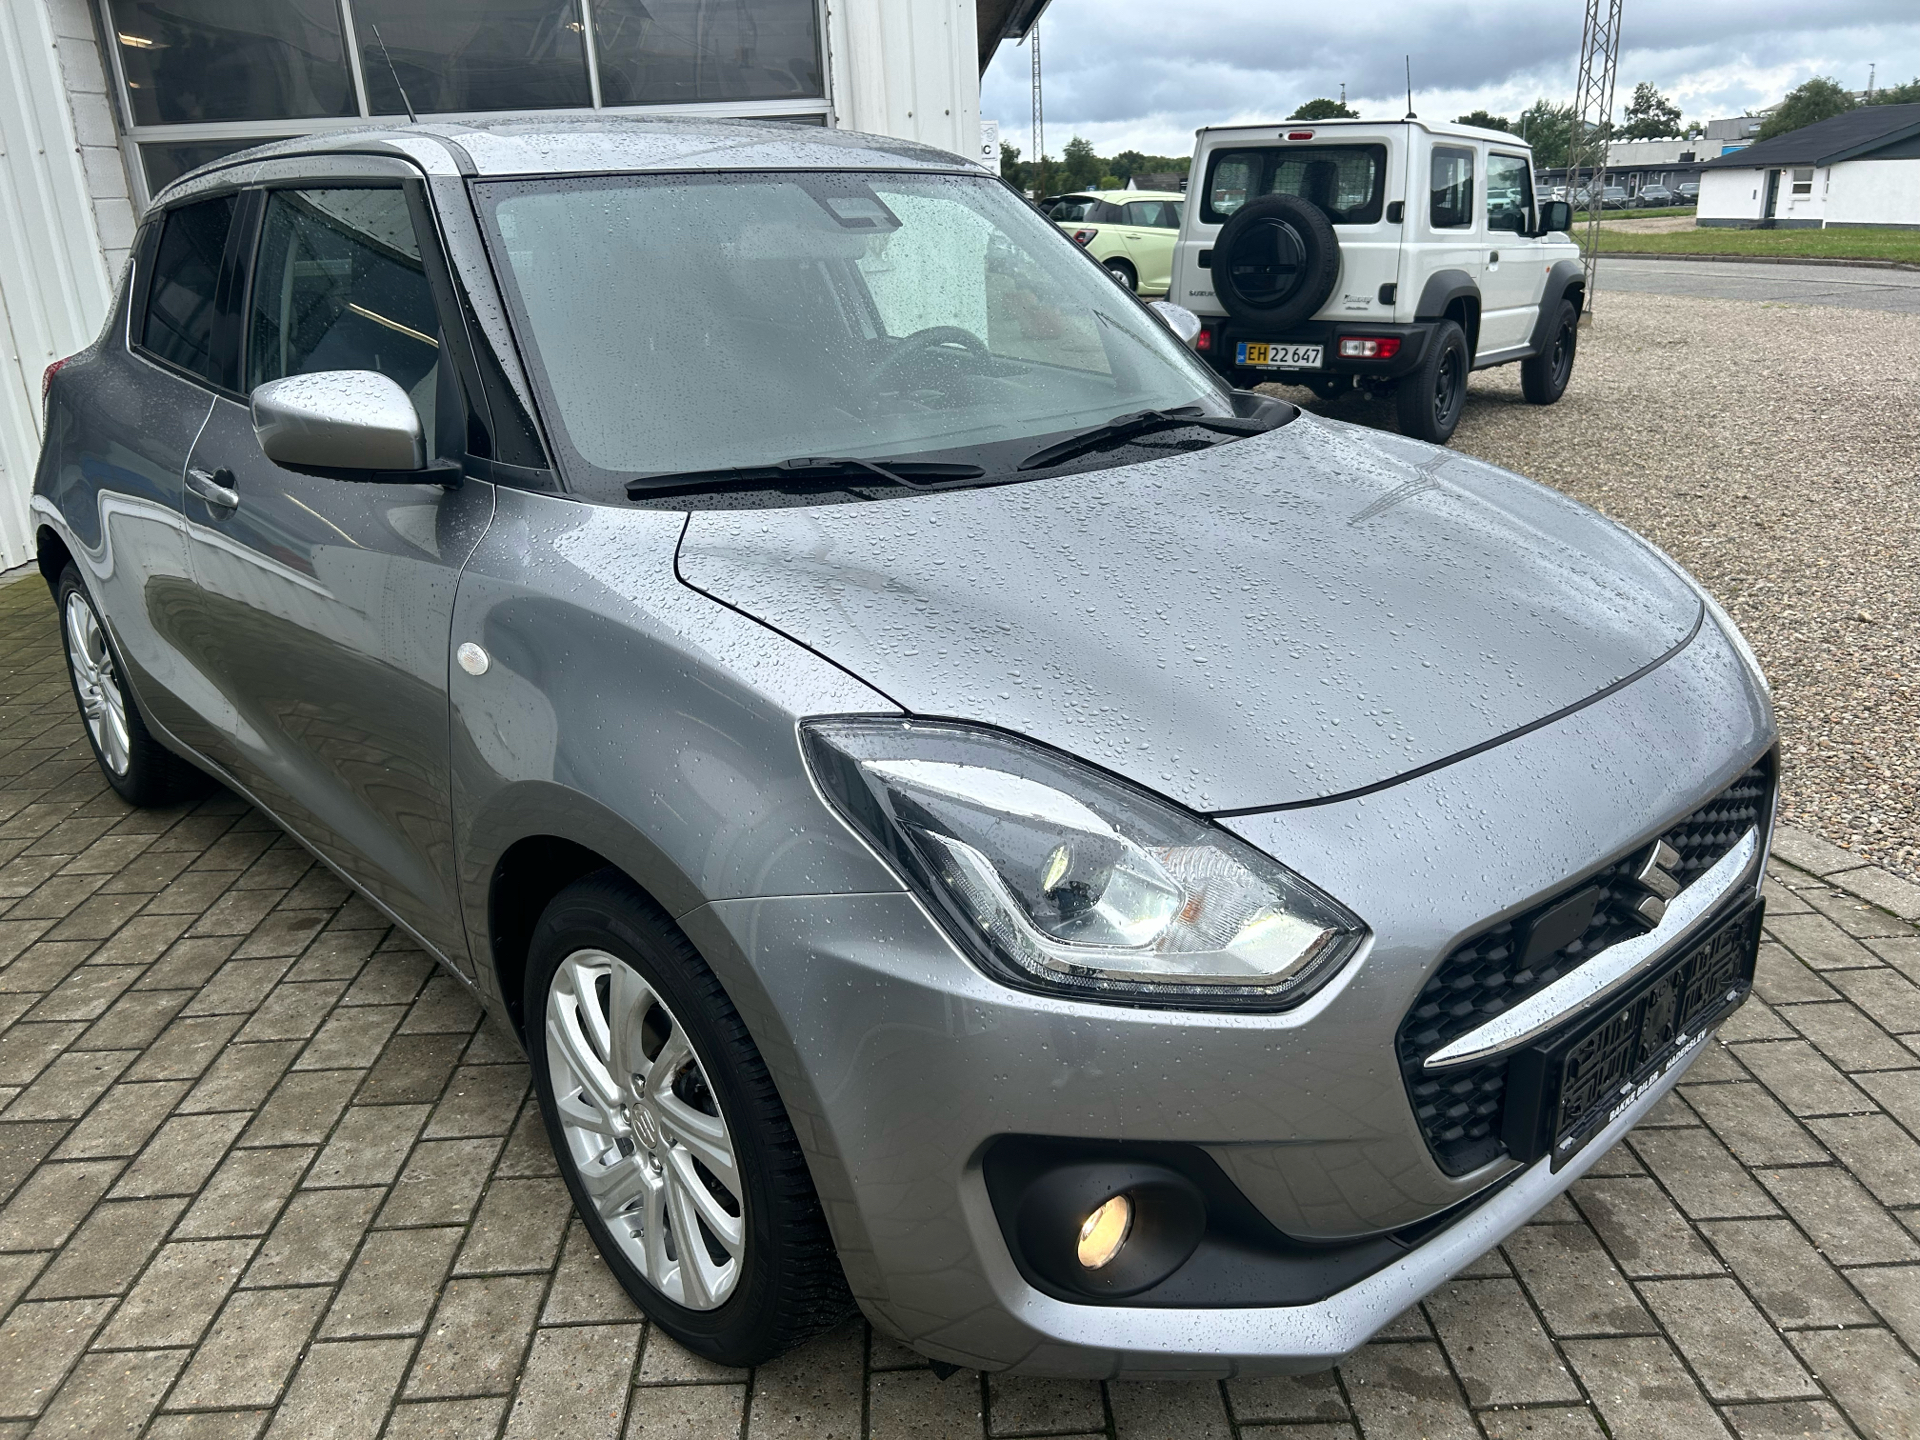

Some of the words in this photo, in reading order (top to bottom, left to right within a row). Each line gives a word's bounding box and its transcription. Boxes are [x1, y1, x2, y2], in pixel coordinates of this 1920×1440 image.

[1247, 346, 1267, 361] EH
[1270, 347, 1288, 362] 22
[1292, 347, 1320, 363] 647
[1609, 1091, 1636, 1122] BAKKE
[1637, 1071, 1659, 1097] BILER
[1665, 1028, 1707, 1071] HADERSLEV
